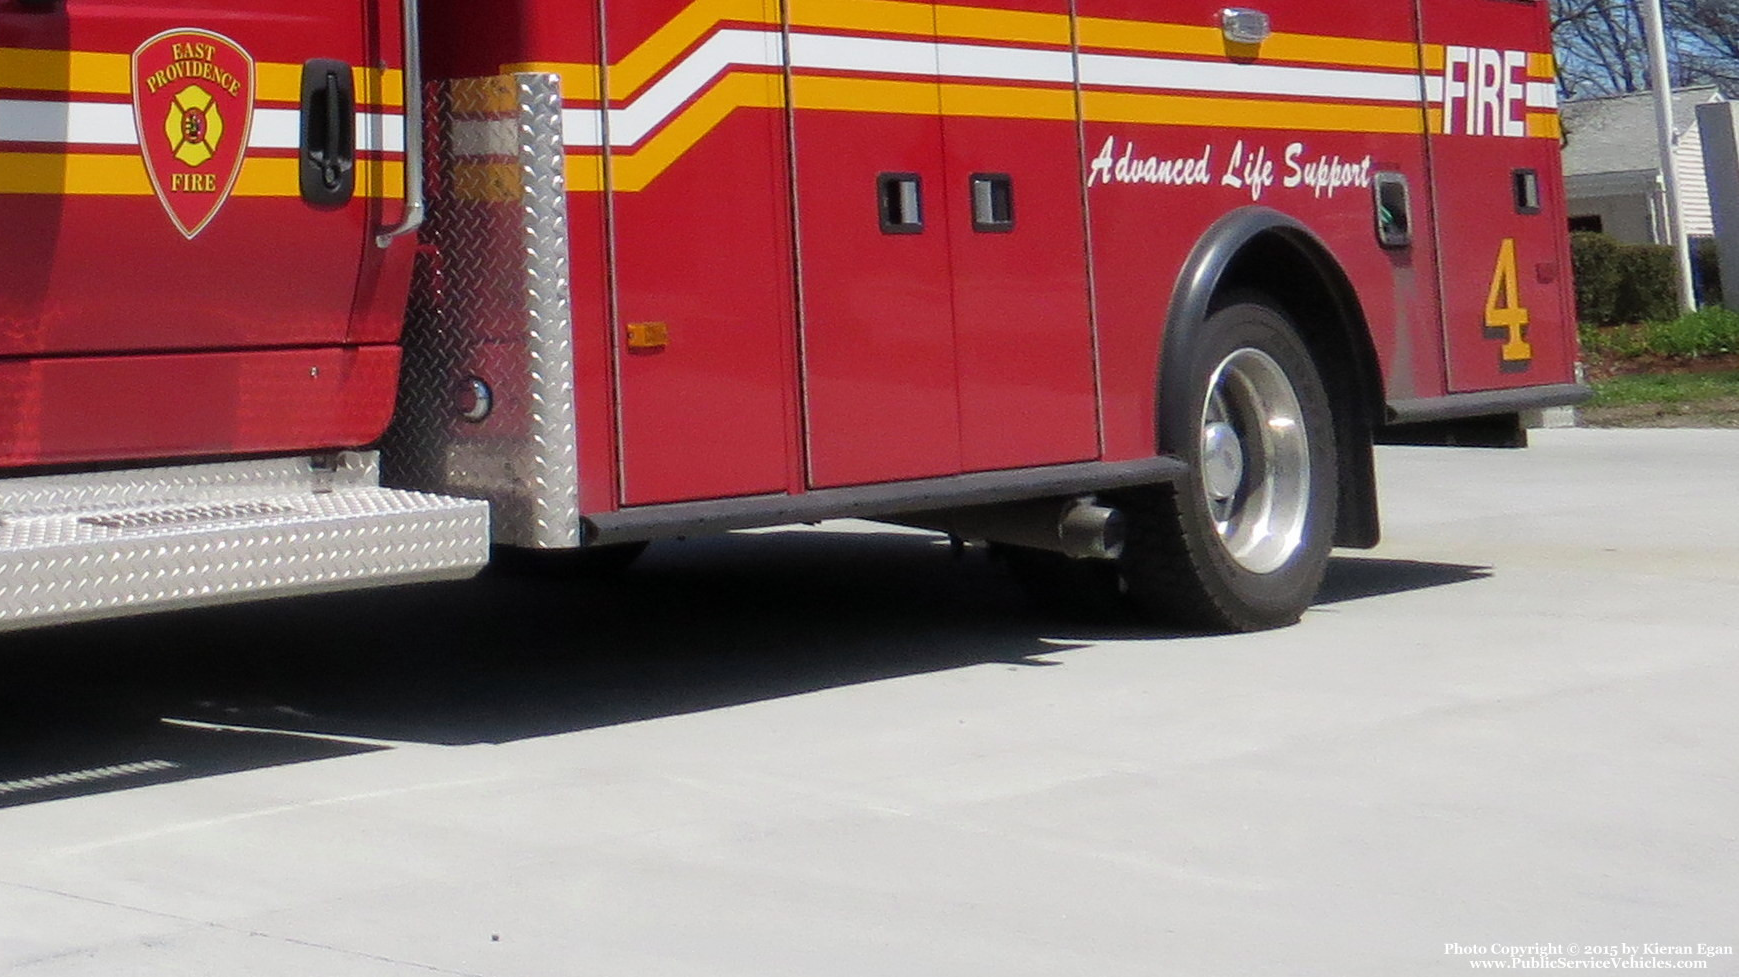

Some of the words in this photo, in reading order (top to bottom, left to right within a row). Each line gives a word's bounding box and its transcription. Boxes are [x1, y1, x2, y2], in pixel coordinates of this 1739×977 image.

[172, 42, 216, 62] EAST
[146, 60, 242, 97] PROVIDENCE
[1442, 45, 1527, 137] FIRE
[171, 173, 217, 192] FIRE
[1088, 135, 1211, 187] Advanced
[1221, 139, 1274, 201] Life
[1283, 142, 1371, 199] Support
[1485, 238, 1533, 362] 4
